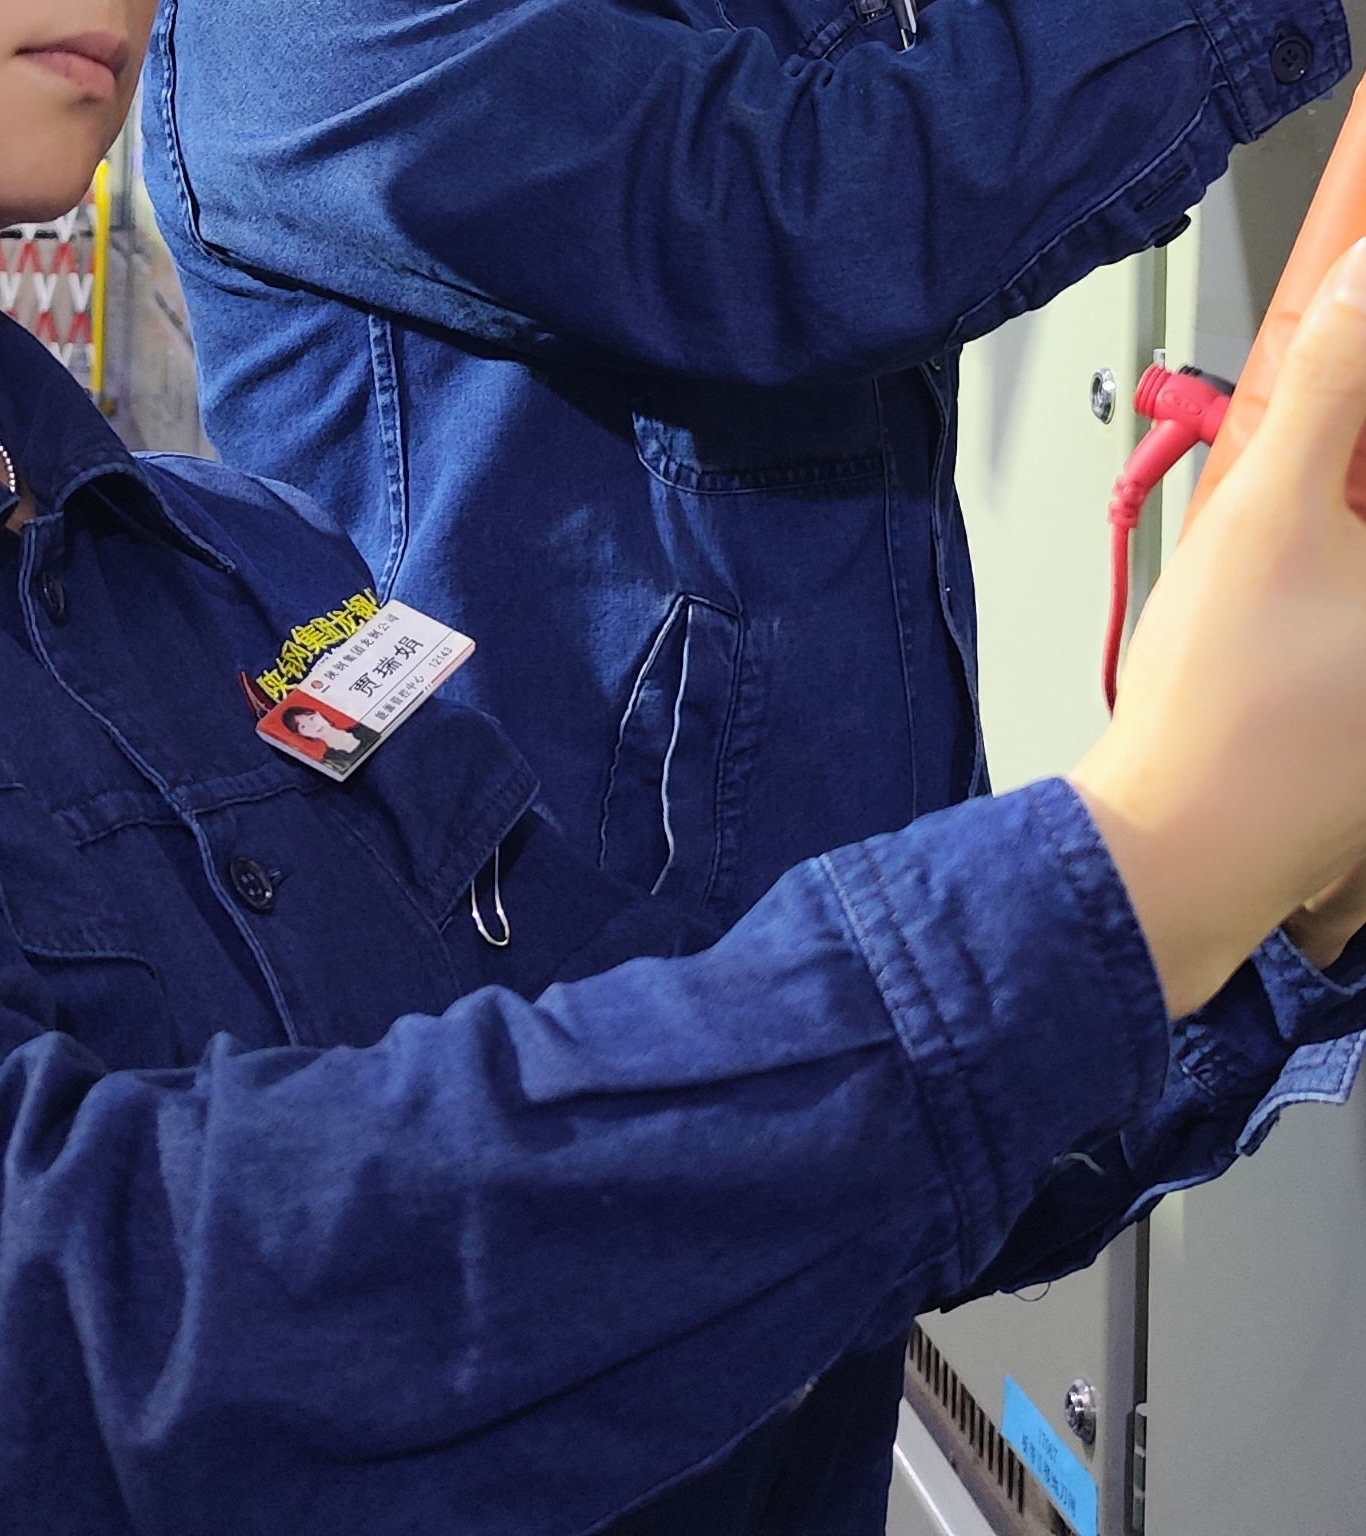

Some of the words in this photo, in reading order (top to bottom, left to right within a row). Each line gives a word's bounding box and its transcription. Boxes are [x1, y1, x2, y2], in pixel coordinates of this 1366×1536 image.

[348, 634, 426, 699] 贾瑞娟
[427, 645, 455, 670] 12143
